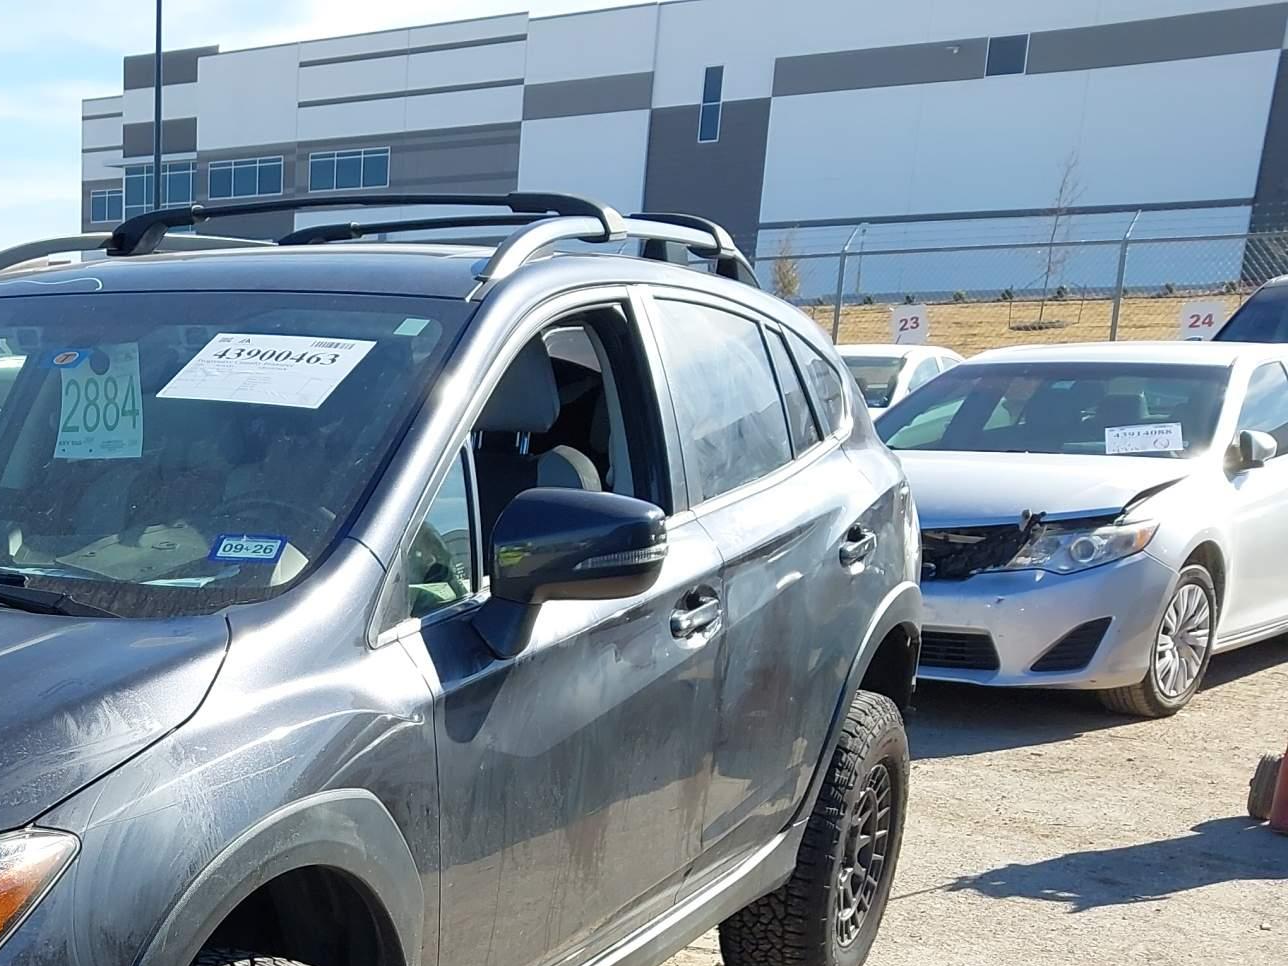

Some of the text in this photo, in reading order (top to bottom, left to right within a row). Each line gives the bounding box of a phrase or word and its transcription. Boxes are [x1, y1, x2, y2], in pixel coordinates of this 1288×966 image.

[899, 316, 920, 331] 23
[1188, 313, 1214, 328] 24
[213, 347, 341, 366] 43900463
[62, 376, 140, 432] 2884
